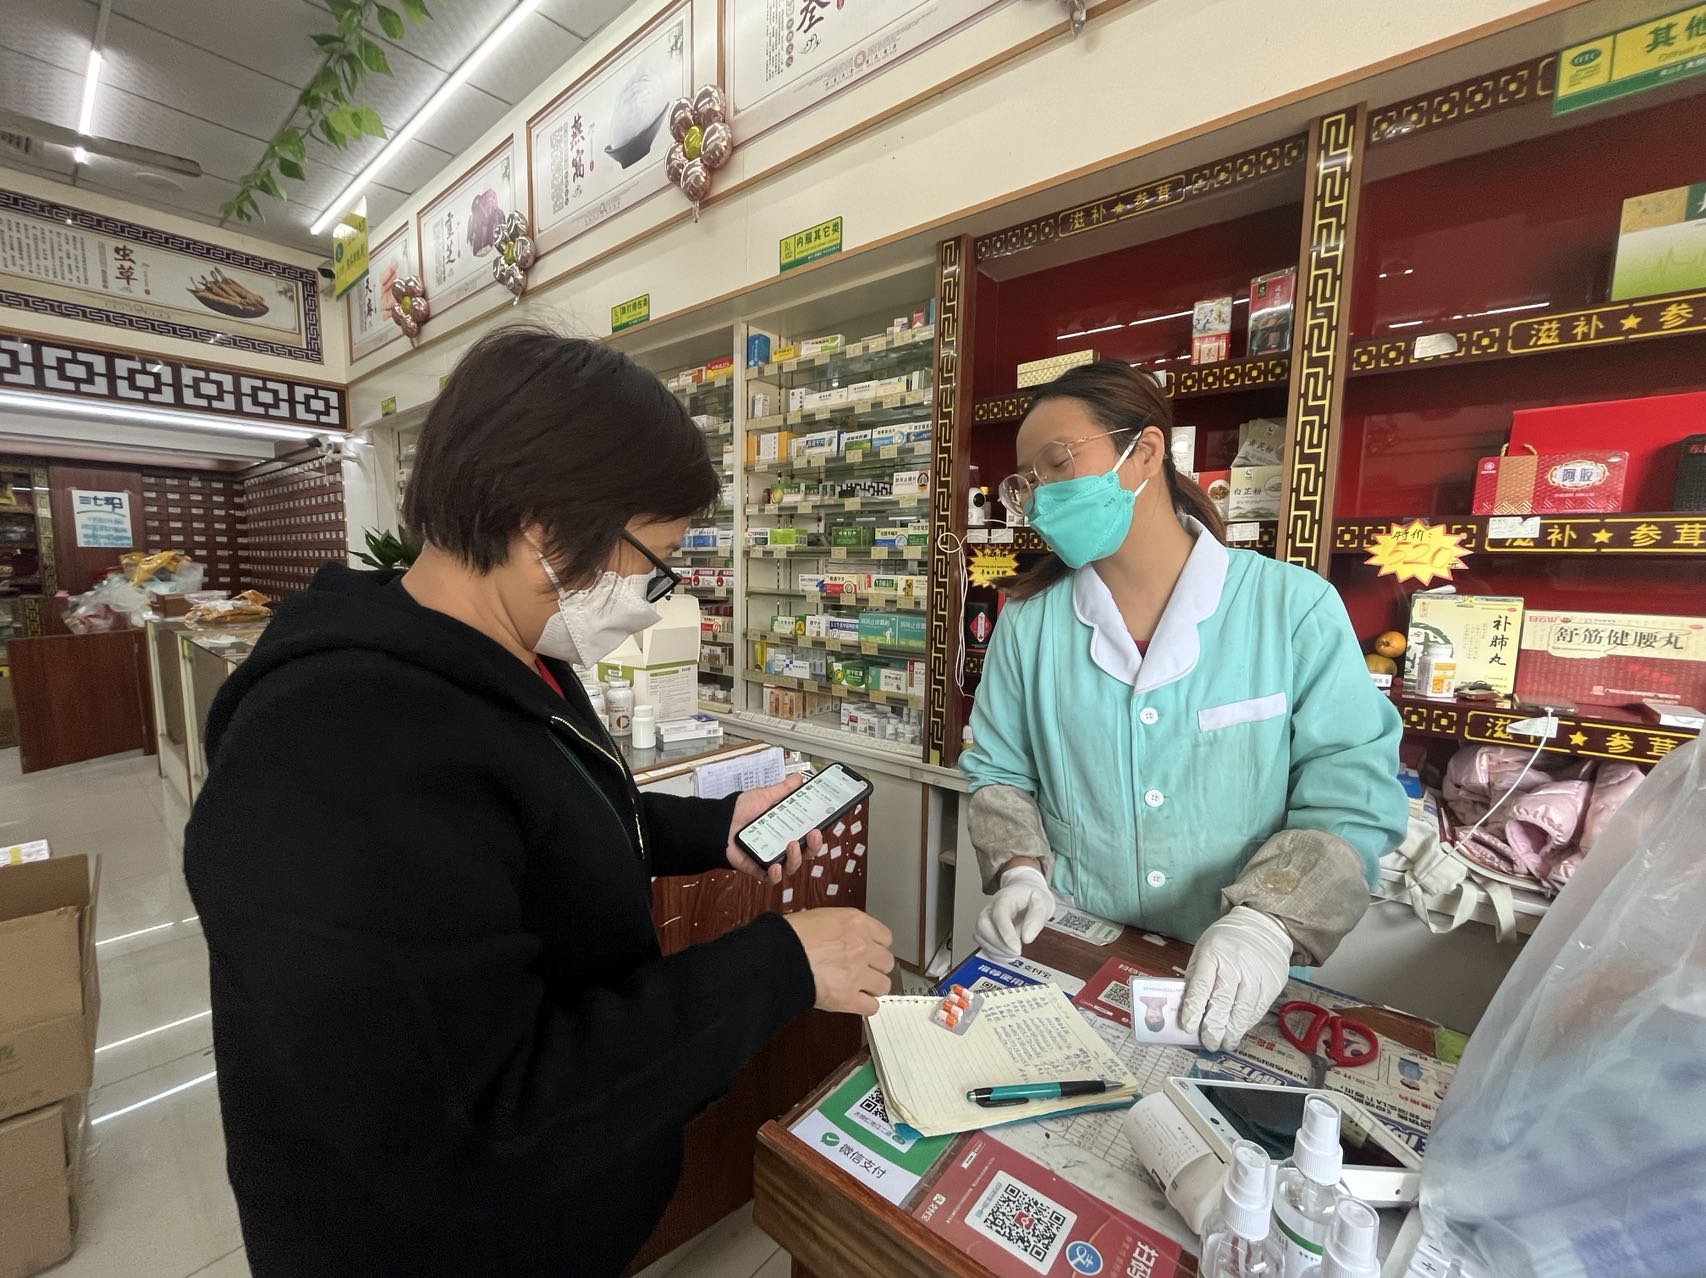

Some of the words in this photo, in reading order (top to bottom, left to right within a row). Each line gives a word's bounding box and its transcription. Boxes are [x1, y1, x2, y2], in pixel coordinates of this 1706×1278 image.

[1069, 205, 1107, 231] 滋补
[1133, 182, 1173, 211] 参茸
[796, 220, 840, 249] 内服其它类
[113, 245, 138, 286] 虫草
[1529, 314, 1604, 347] 滋补
[1659, 302, 1706, 329] 参
[1562, 467, 1594, 482] 阿胶
[1629, 522, 1706, 548] 参茸
[1386, 541, 1454, 569] 520
[1488, 614, 1512, 667] 补肺丸
[1556, 626, 1684, 650] 舒筋健腰丸
[1605, 732, 1678, 760] 参茸
[1022, 962, 1053, 981] 支付宝
[837, 1141, 888, 1180] 微信支付
